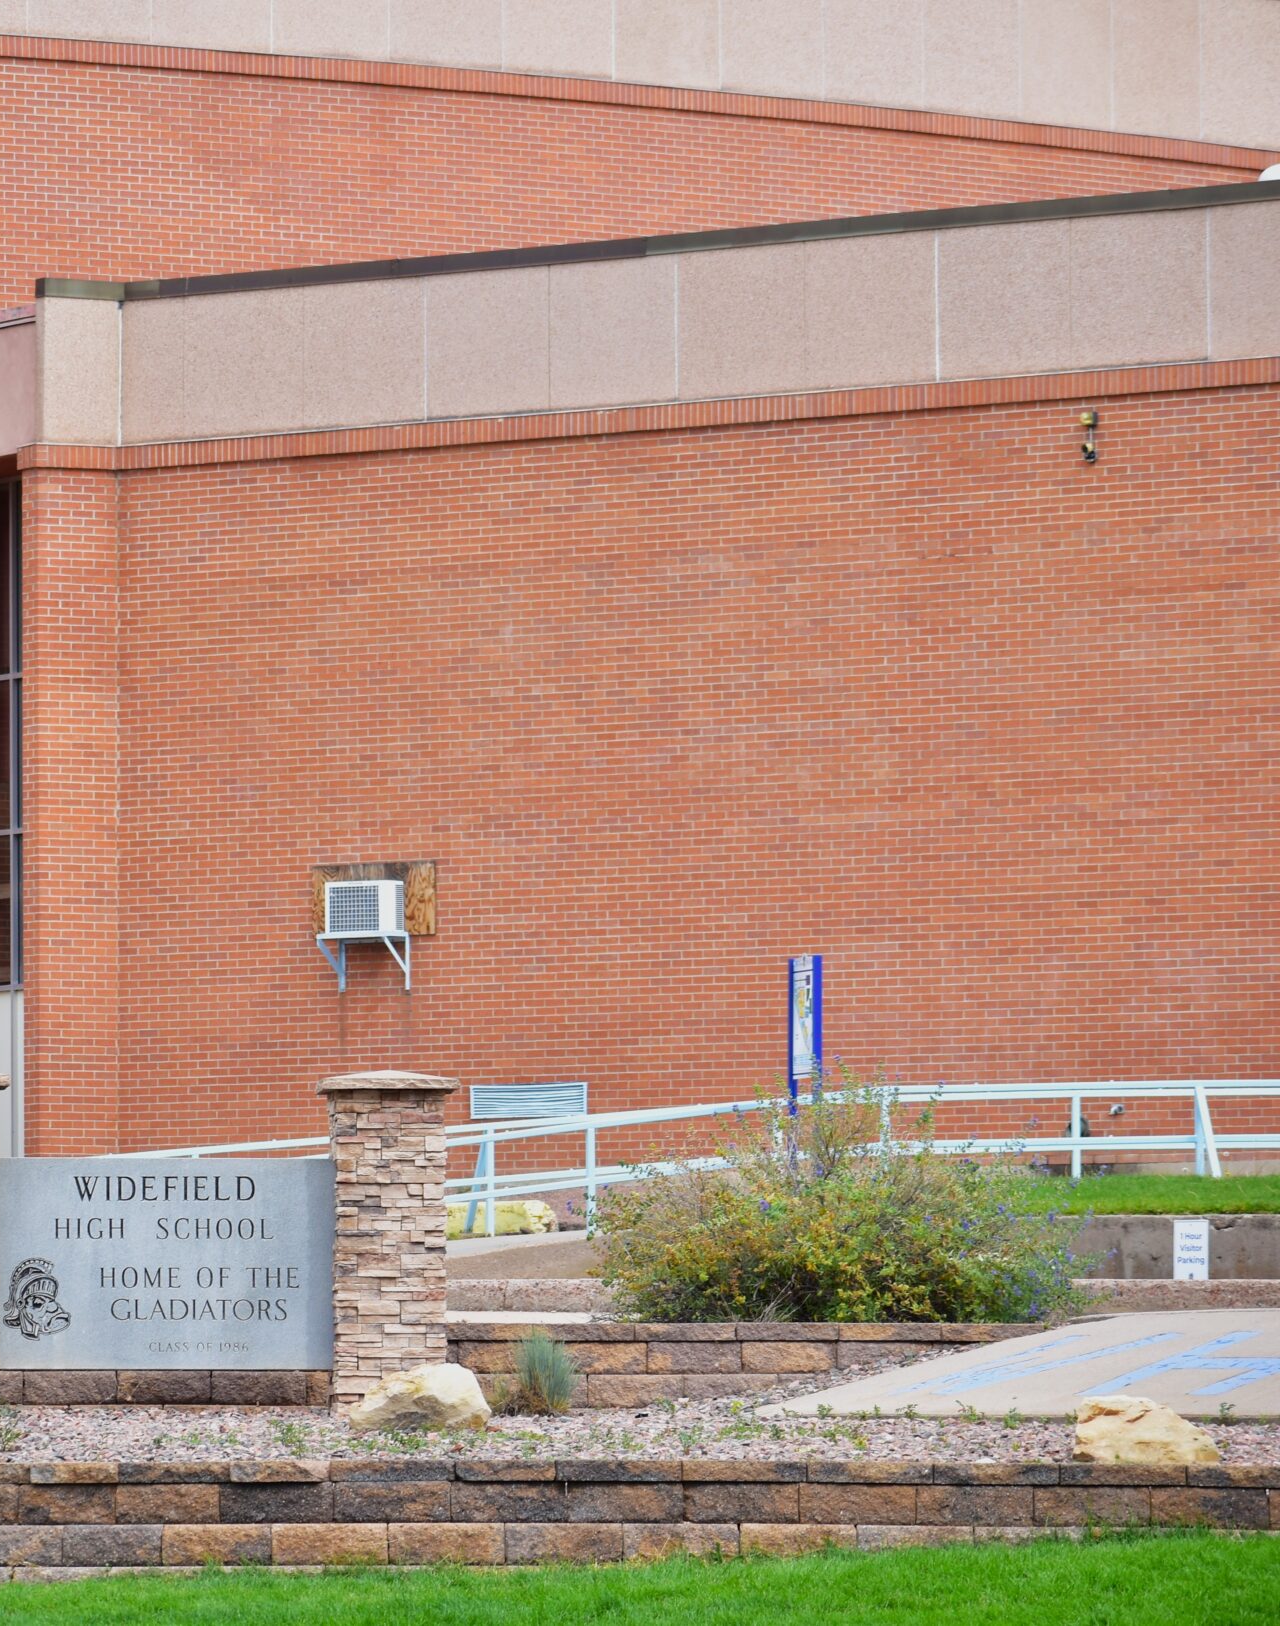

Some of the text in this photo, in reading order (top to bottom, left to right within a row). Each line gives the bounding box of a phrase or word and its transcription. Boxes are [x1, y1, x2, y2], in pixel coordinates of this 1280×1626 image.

[74, 1176, 257, 1201] WIDEFIELD
[54, 1218, 275, 1240] HIGH SCHOOL
[1177, 1256, 1205, 1265] Parking
[100, 1267, 301, 1289] HOME OF THE
[110, 1299, 288, 1321] GLADIATORS
[148, 1342, 249, 1353] CLASS OF 1986
